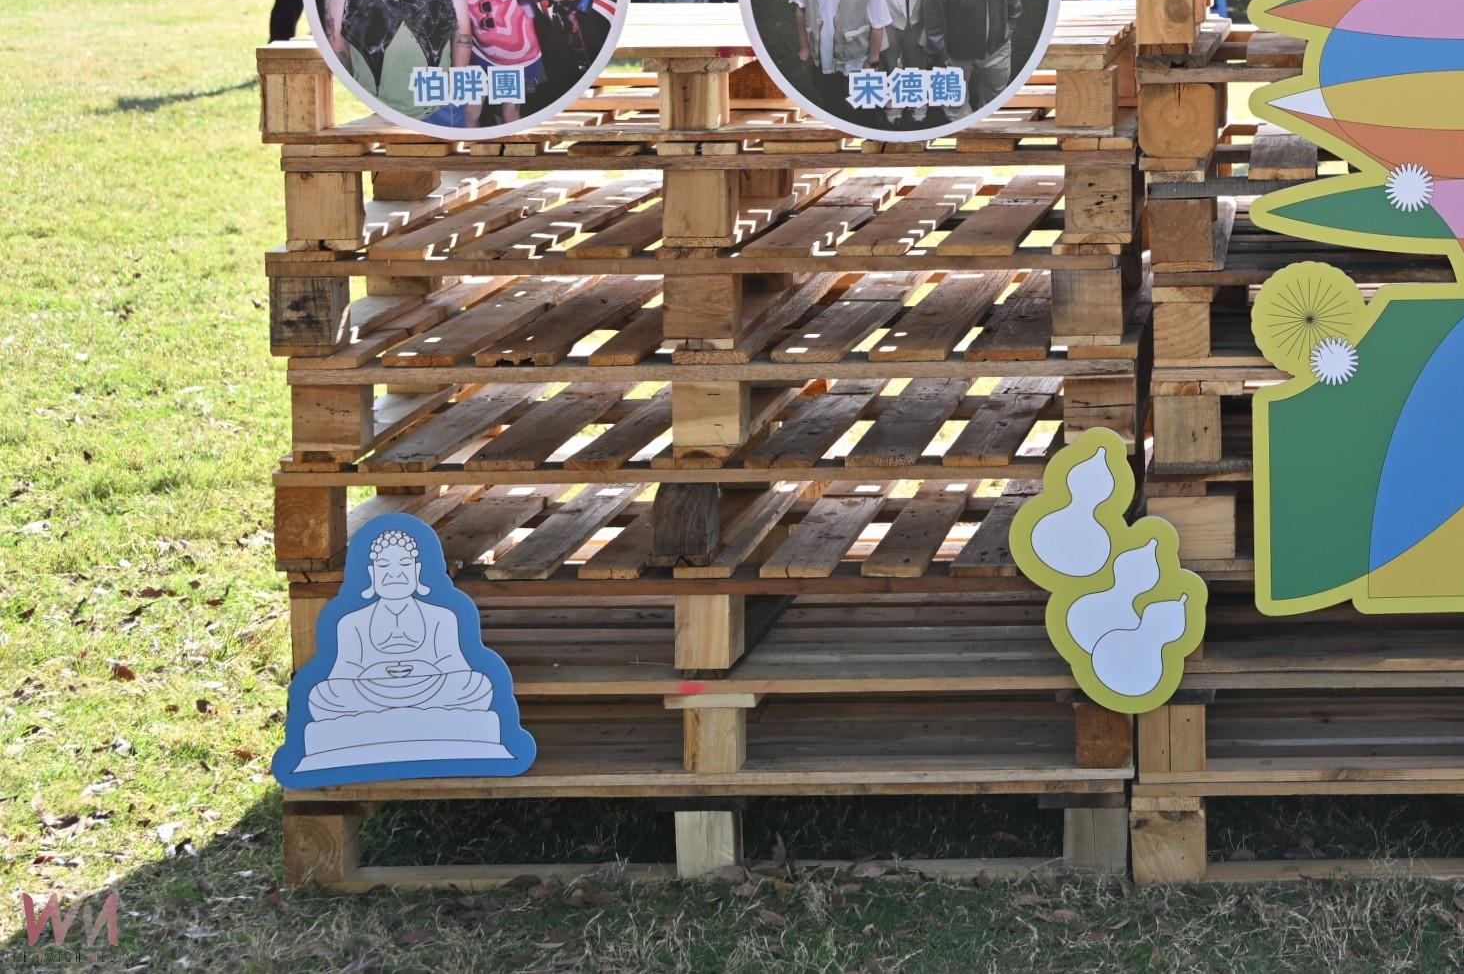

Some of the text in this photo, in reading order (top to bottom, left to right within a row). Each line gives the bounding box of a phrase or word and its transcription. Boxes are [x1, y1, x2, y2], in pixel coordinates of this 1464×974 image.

[413, 69, 523, 103] 怕胖團
[853, 71, 962, 104] 宋德鶴
